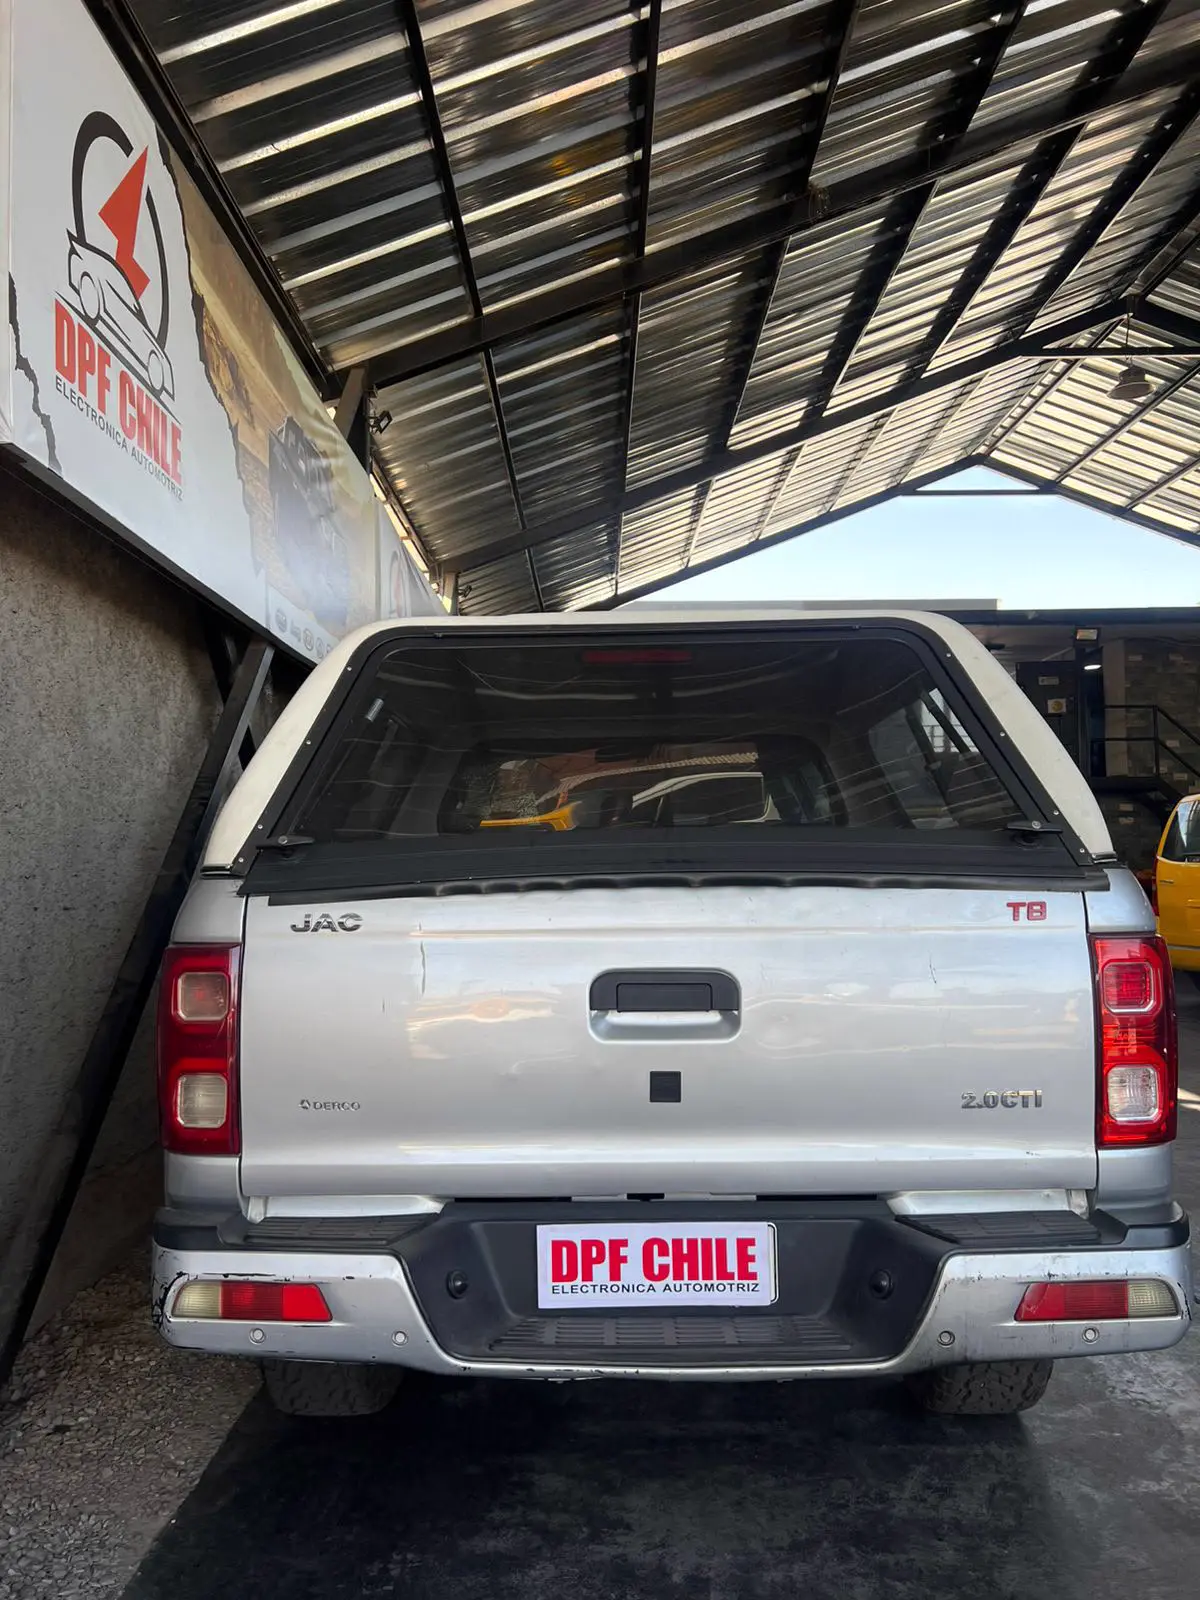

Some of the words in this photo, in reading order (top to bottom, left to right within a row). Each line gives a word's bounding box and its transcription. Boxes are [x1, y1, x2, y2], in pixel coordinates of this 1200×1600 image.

[55, 299, 111, 415] DPF
[119, 369, 182, 485] CHILE
[56, 375, 129, 453] ELECTRONICA
[131, 446, 183, 500] AUTOMOTRIZ
[290, 912, 363, 932] JAC
[313, 1101, 360, 1110] DERCO
[961, 1090, 1043, 1109] 2.0CTI
[551, 1239, 628, 1282] DPF
[642, 1237, 757, 1281] CHILE
[552, 1284, 656, 1294] ELECTRONICA
[663, 1283, 759, 1292] AUTOMOTRIZ
